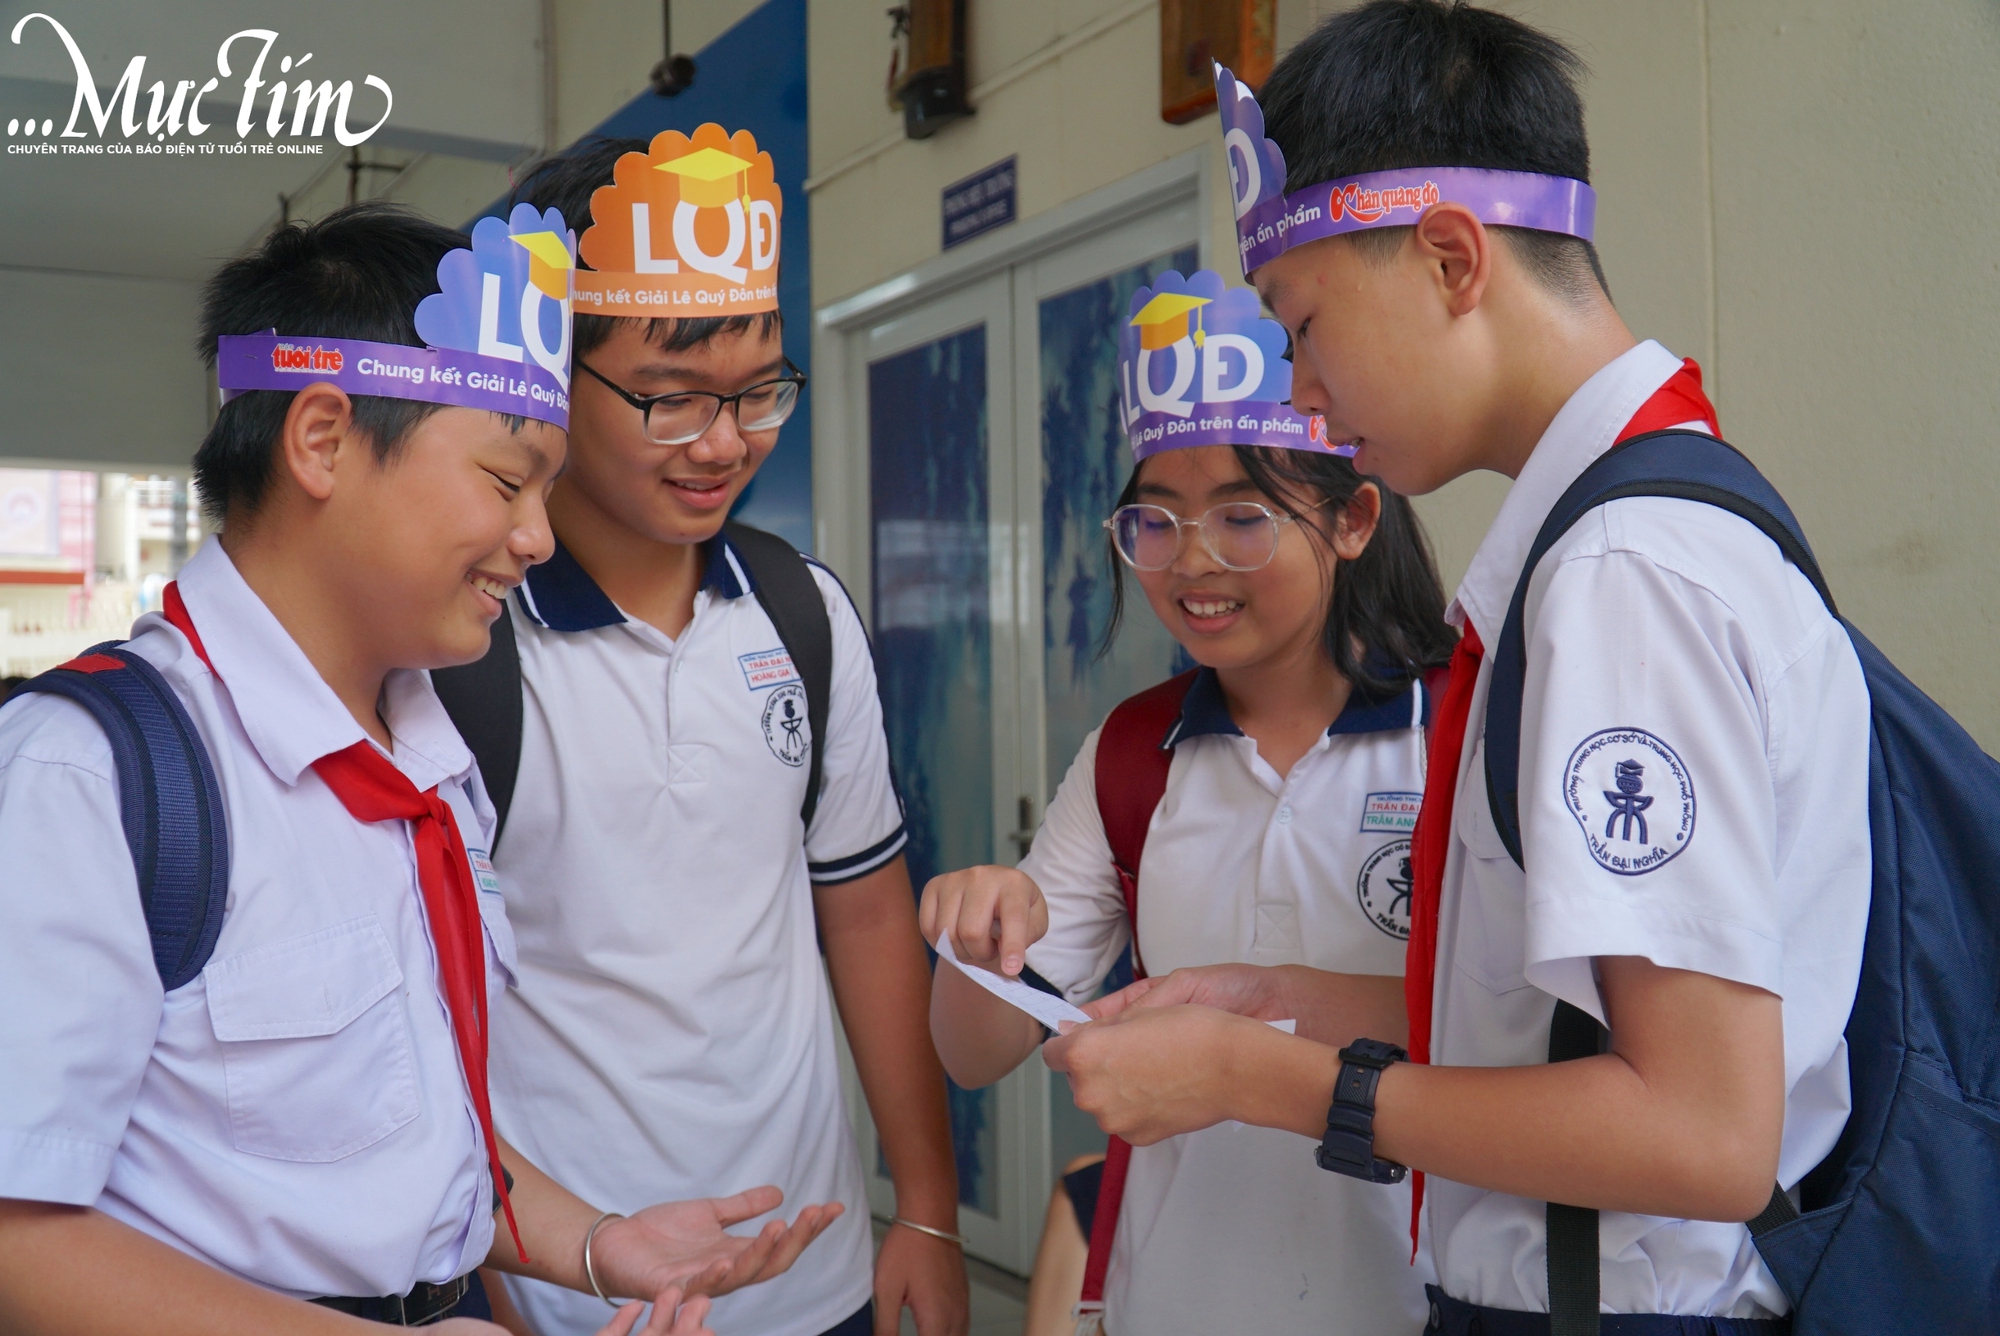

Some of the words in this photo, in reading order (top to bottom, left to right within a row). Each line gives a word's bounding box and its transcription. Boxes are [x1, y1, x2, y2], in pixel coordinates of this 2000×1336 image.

[1381, 186, 1423, 214] quàng
[632, 198, 777, 285] LQĐ
[1257, 223, 1275, 243] ấn
[1276, 204, 1321, 237] phẩm
[573, 290, 602, 306] hung
[606, 288, 631, 304] kết
[634, 290, 669, 305] Giải
[672, 287, 691, 305] Lê
[695, 288, 726, 306] Quý
[729, 287, 754, 302] Đôn
[357, 358, 425, 384] Chung
[430, 366, 463, 386] kết
[467, 371, 504, 393] Giải
[508, 378, 527, 397] Lê
[530, 383, 556, 408] Quý
[1123, 334, 1265, 426] LQĐ
[1143, 423, 1165, 442] Quý
[1167, 419, 1197, 435] Đôn
[1199, 416, 1234, 430] trên
[1237, 414, 1259, 430] ấn
[1262, 416, 1304, 434] phẩm
[1573, 748, 1591, 773] TRUNG
[1589, 738, 1607, 751] HỌC
[1648, 740, 1672, 762] TRUNG
[1670, 761, 1683, 780] HỌC
